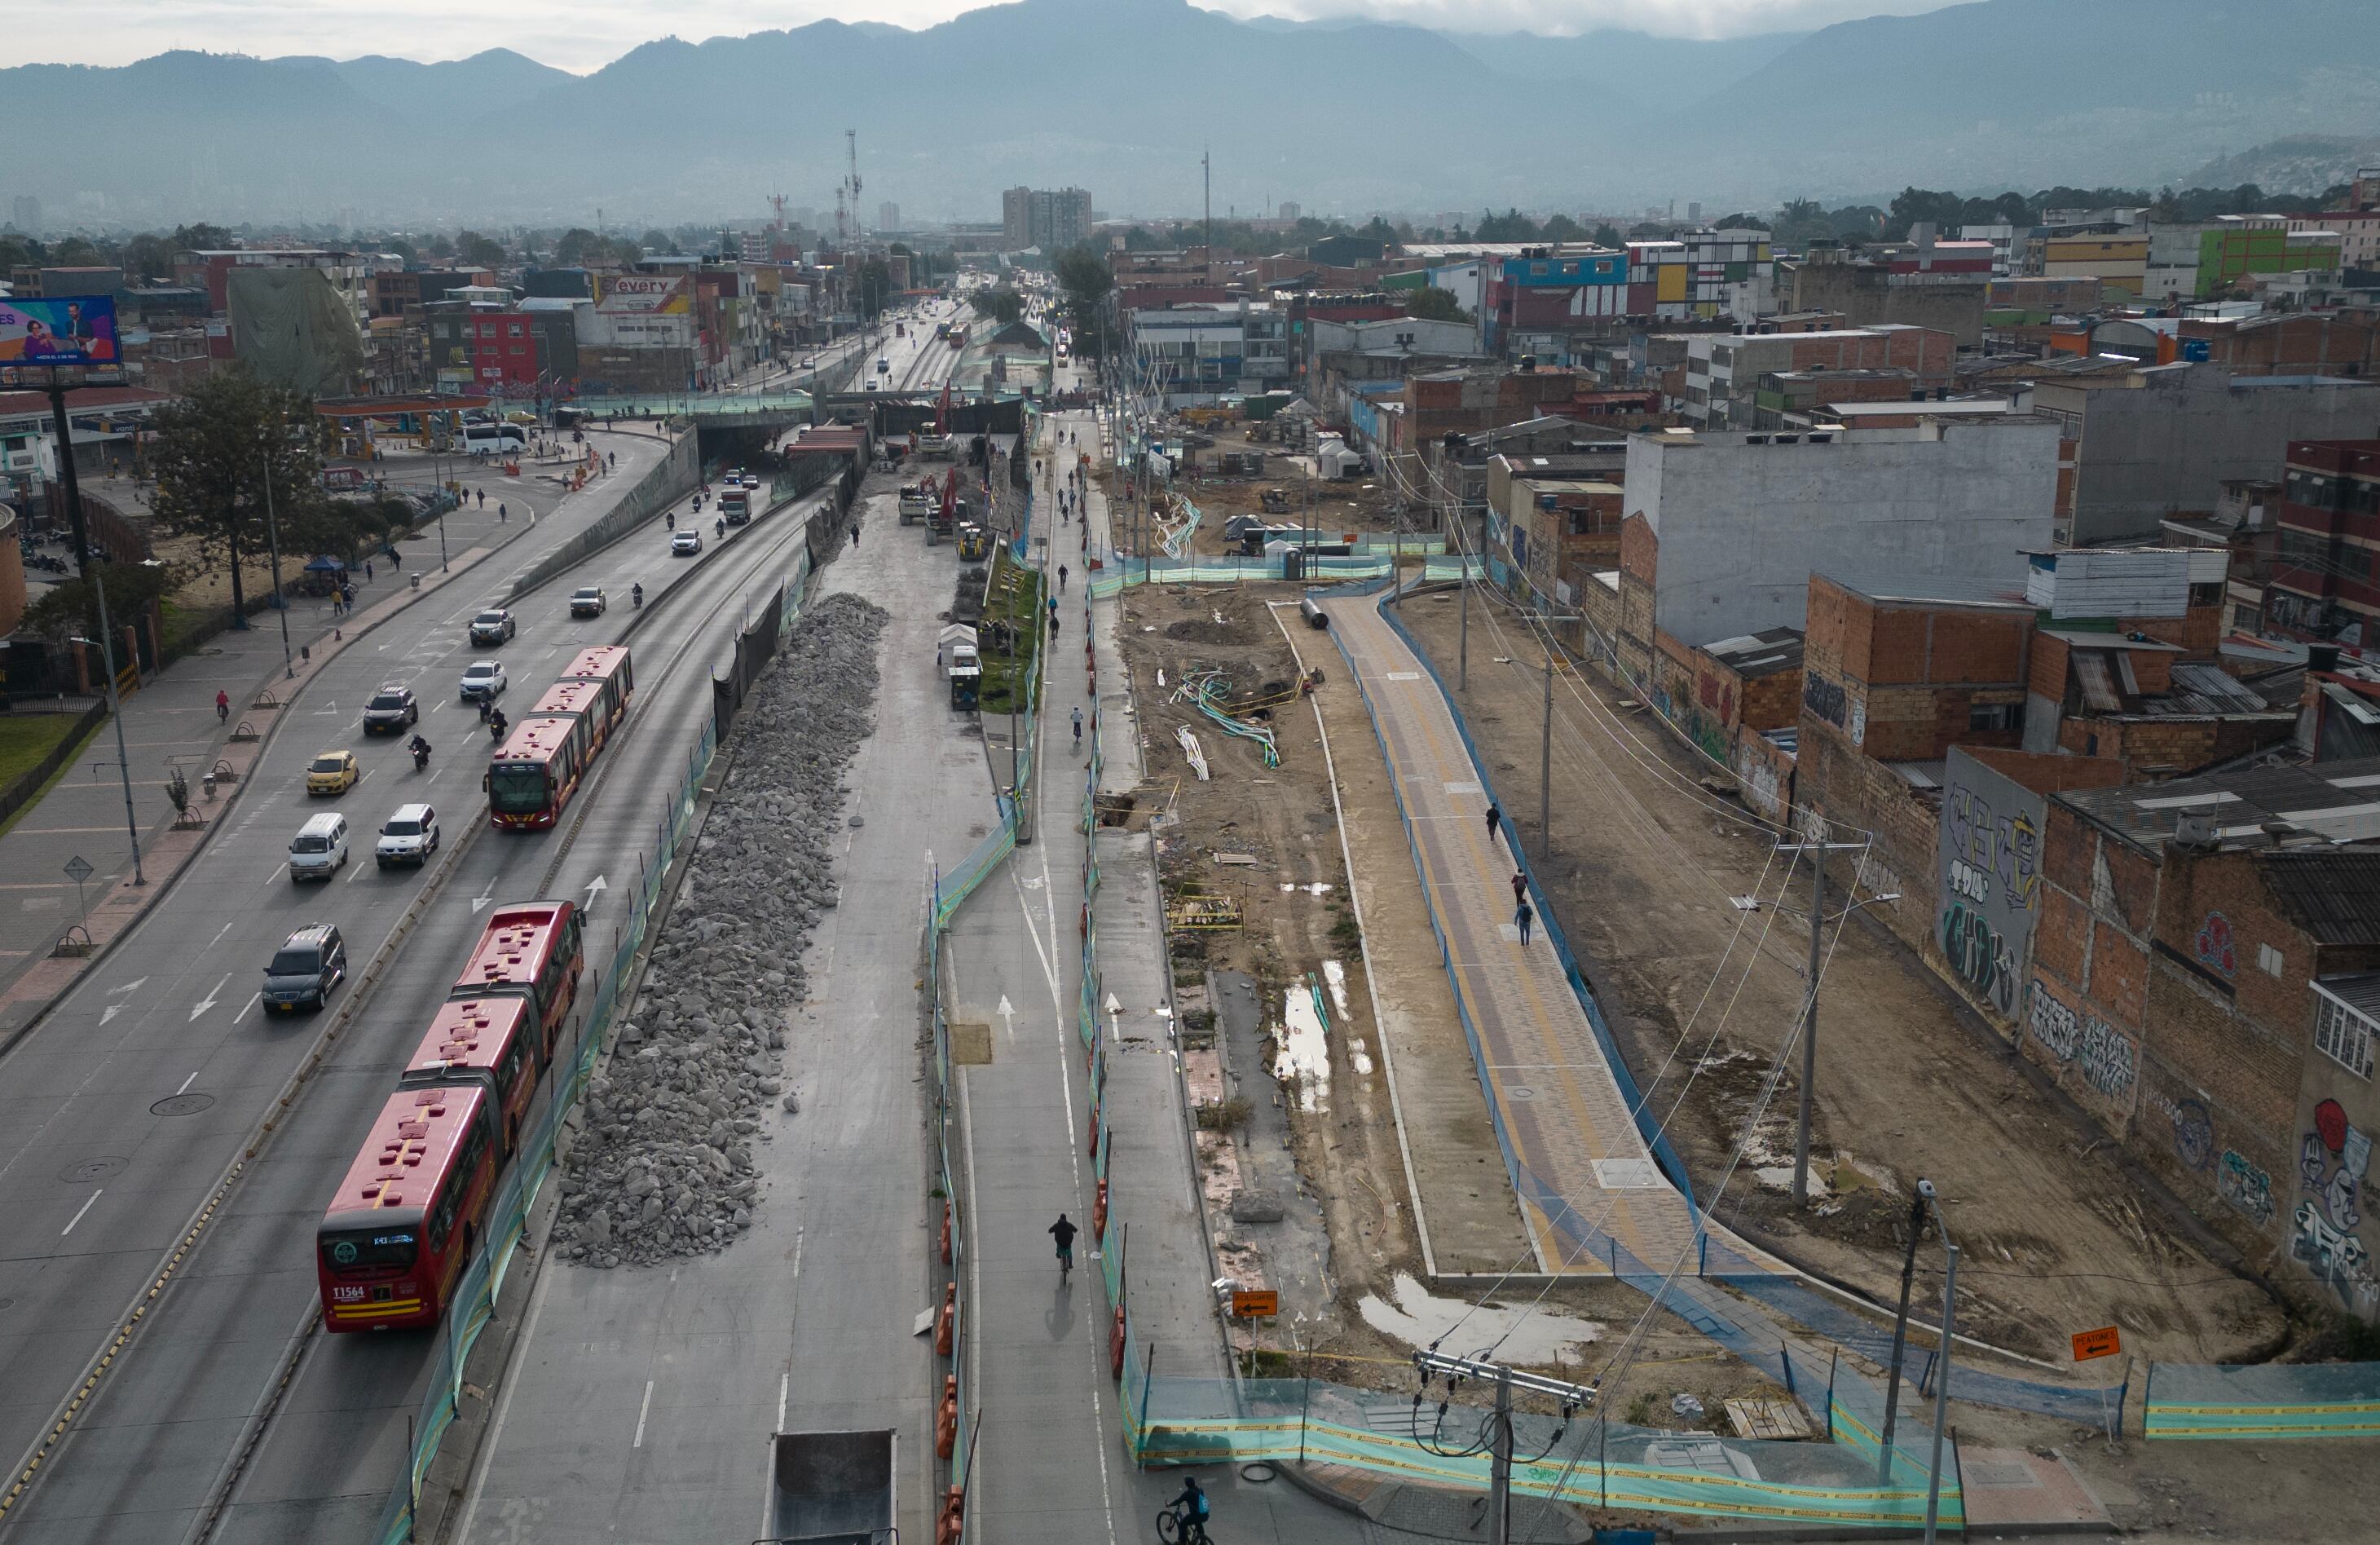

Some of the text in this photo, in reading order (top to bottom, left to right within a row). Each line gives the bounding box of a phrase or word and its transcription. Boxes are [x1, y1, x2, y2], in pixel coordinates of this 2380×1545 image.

[619, 281, 668, 294] every
[333, 1286, 364, 1297] T1564
[2076, 1330, 2115, 1345] PEATONES
